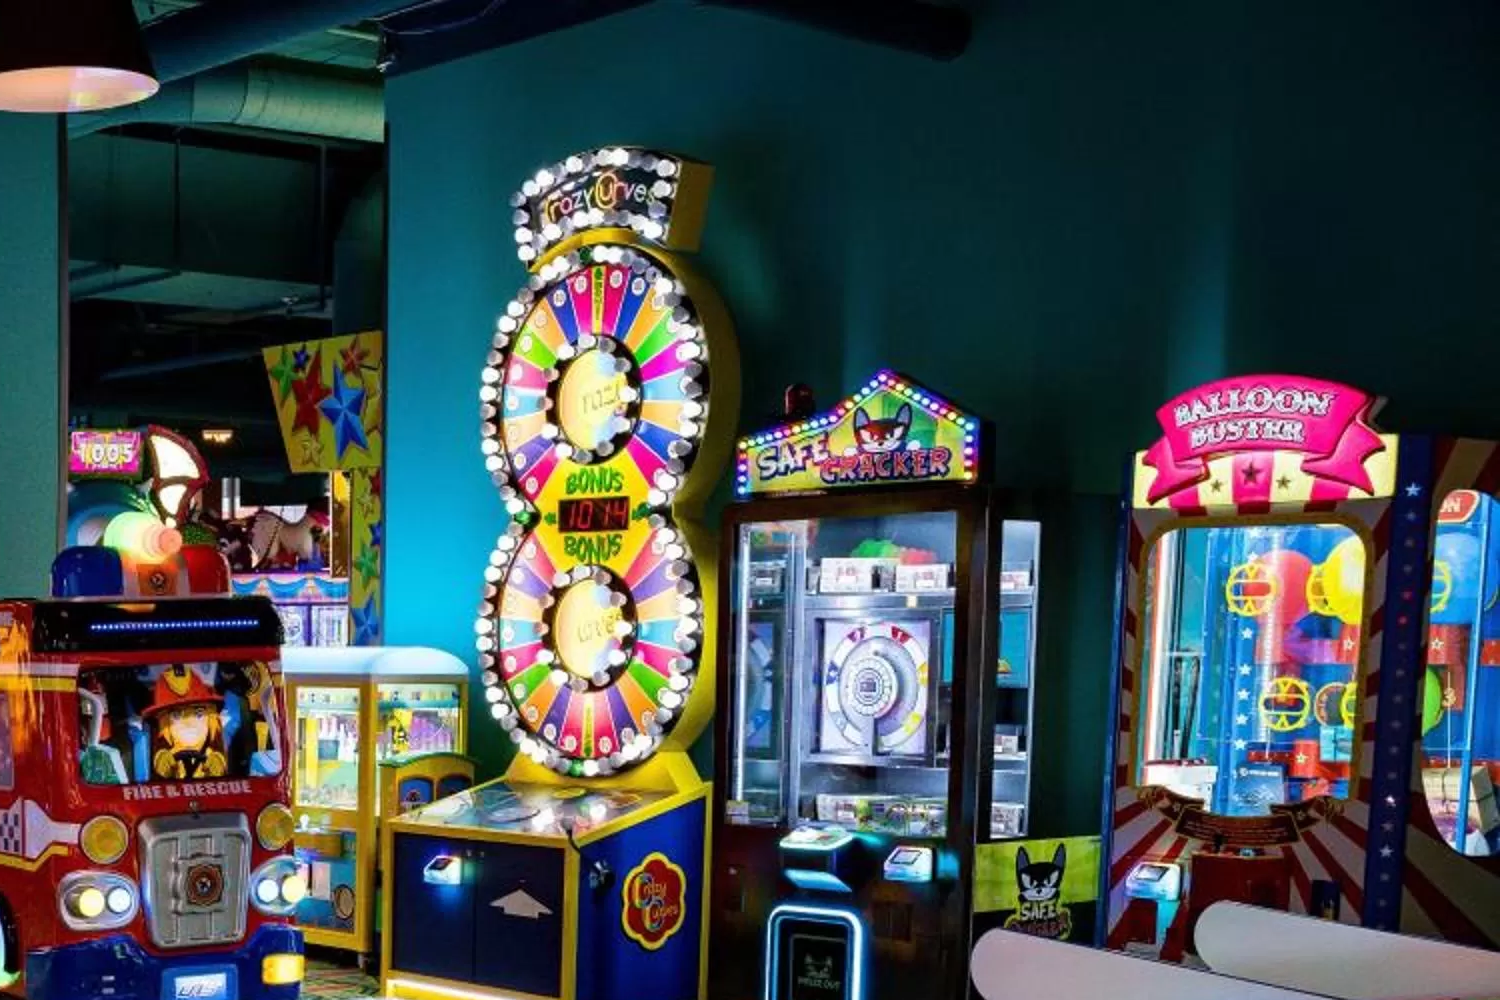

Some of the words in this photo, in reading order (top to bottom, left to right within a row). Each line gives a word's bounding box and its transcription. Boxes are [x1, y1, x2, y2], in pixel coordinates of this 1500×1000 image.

[1174, 386, 1334, 427] BALLOON
[1189, 418, 1305, 449] BUSTER
[756, 436, 830, 480] SAFE
[819, 446, 953, 484] CRACKER
[566, 467, 623, 494] BONUS
[564, 534, 622, 562] BONUS
[123, 784, 164, 800] FIRE
[182, 780, 252, 797] RESCUE
[1021, 902, 1057, 921] SAFE
